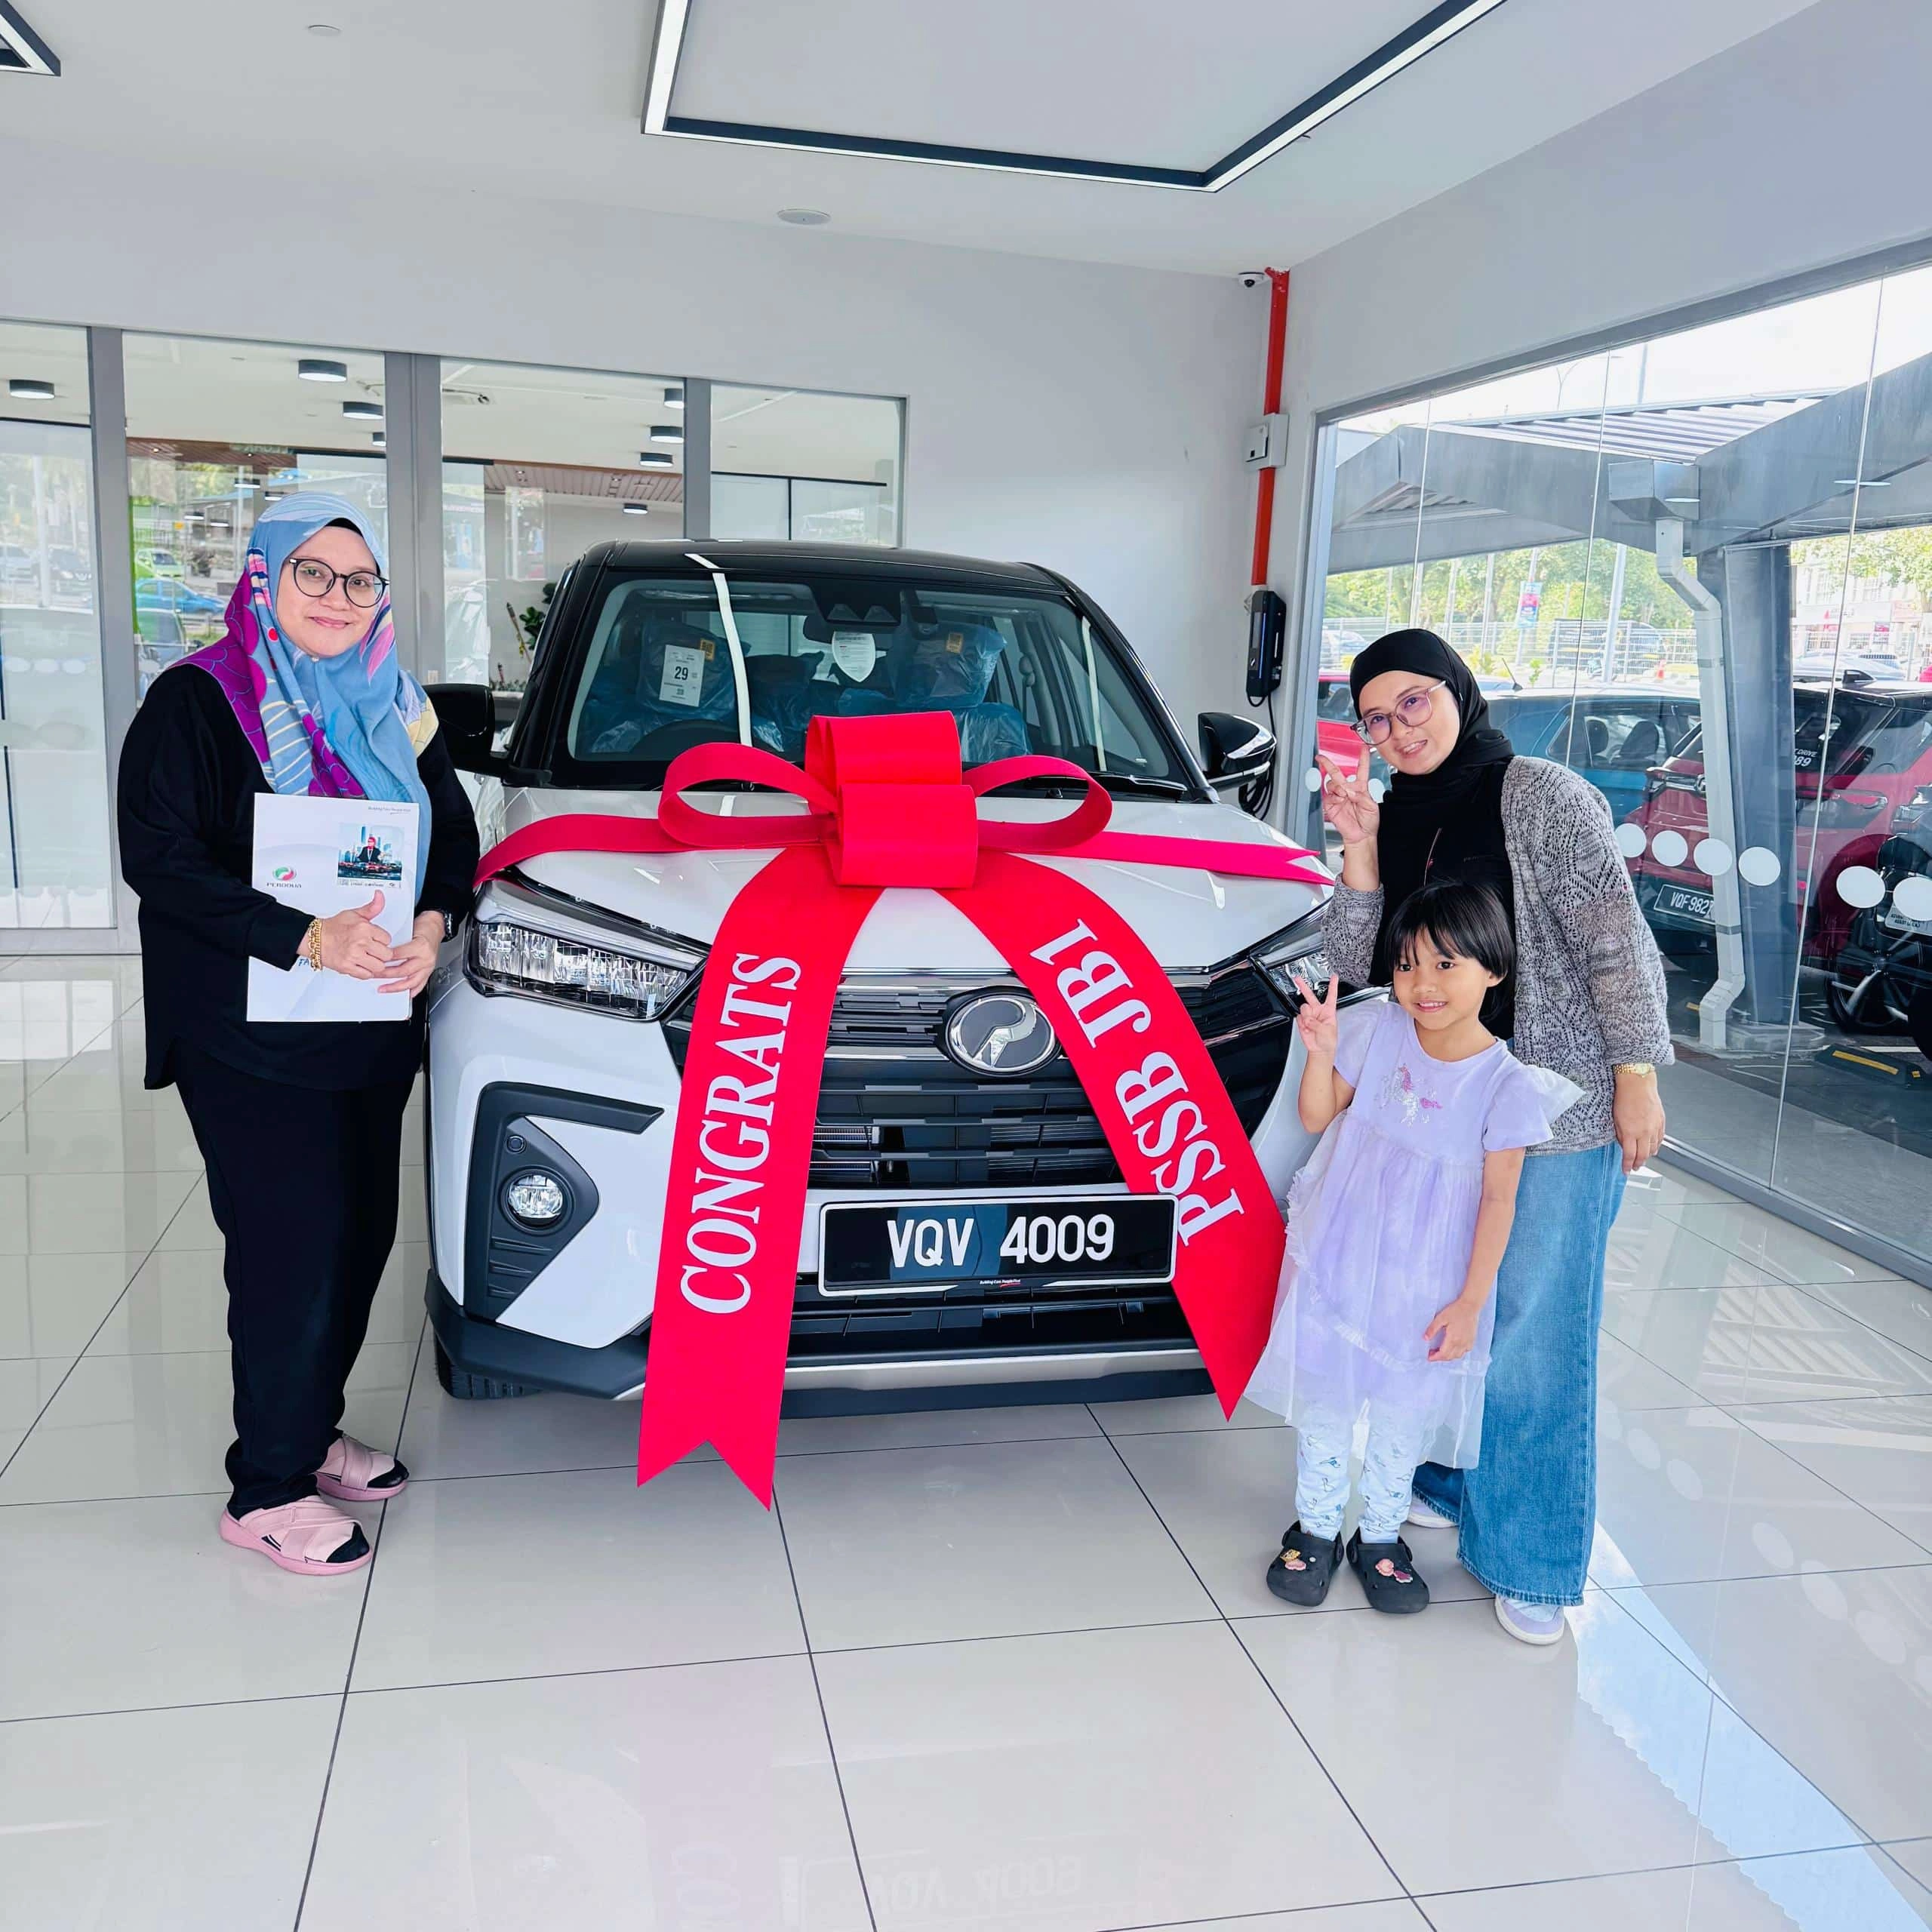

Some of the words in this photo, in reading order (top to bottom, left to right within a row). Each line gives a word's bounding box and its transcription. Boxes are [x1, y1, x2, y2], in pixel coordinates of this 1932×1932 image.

[674, 666, 689, 681] 29
[1794, 755, 1812, 767] 89
[1670, 891, 1690, 909] VQF
[1029, 918, 1152, 1049] JB1
[680, 952, 802, 1315] CONGRATS
[1115, 1051, 1245, 1247] PSSB
[886, 1217, 975, 1269] VQV
[998, 1213, 1115, 1264] 4009
